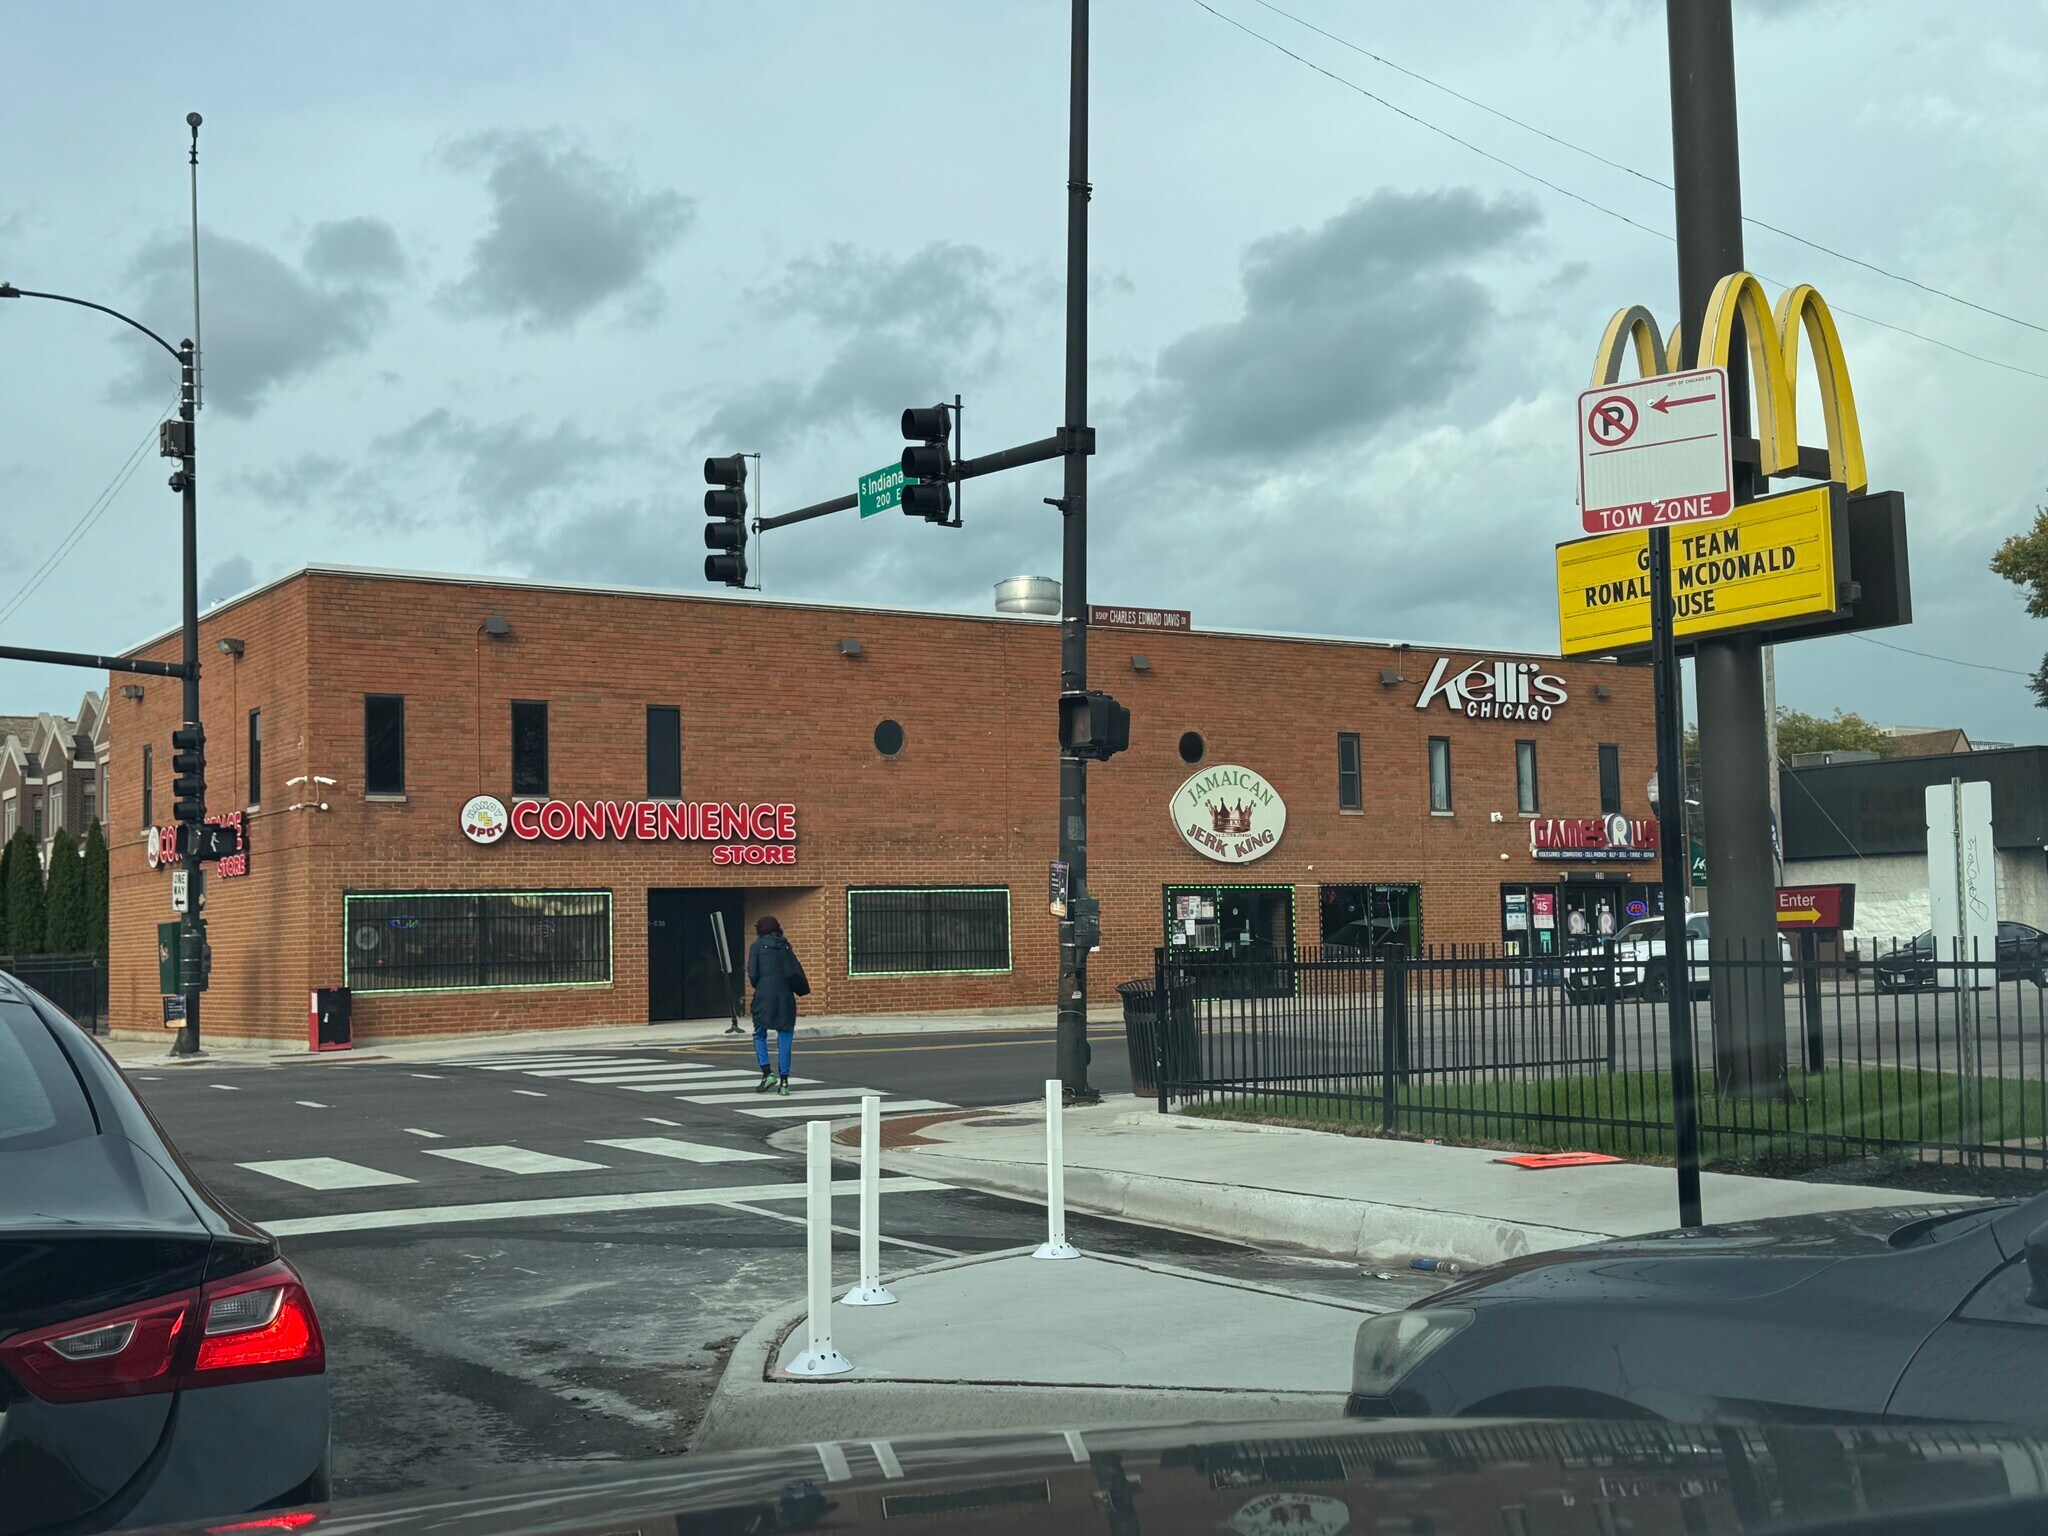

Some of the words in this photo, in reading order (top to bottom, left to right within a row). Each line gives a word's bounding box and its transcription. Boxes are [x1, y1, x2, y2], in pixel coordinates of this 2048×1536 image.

[862, 483, 867, 494] S
[869, 471, 904, 495] Indiana
[876, 493, 891, 508] 200
[1600, 507, 1643, 528] TOW
[1653, 496, 1713, 522] ZONE
[1682, 528, 1739, 561] TEAM
[1585, 576, 1651, 608] RONAL
[1679, 546, 1796, 590] MCDONALD
[1109, 610, 1136, 624] CHARLES
[1138, 611, 1161, 626] EDWARD
[1163, 613, 1180, 627] DAVIS
[1415, 657, 1568, 710] Kelli's
[1466, 701, 1552, 721] CHICAGO
[1187, 770, 1274, 807] JAMAICAN
[466, 801, 503, 820] HANDY
[511, 800, 796, 840] CONVENIENCE
[466, 823, 504, 838] SPOT
[1186, 823, 1229, 858] JERK
[1234, 828, 1275, 858] KING
[1531, 820, 1607, 848] GAMES
[1631, 820, 1659, 848] US
[217, 854, 246, 878] STORE
[713, 845, 796, 865] STORE
[174, 874, 186, 884] ONE
[174, 886, 185, 896] WAY
[1779, 894, 1815, 907] Enter
